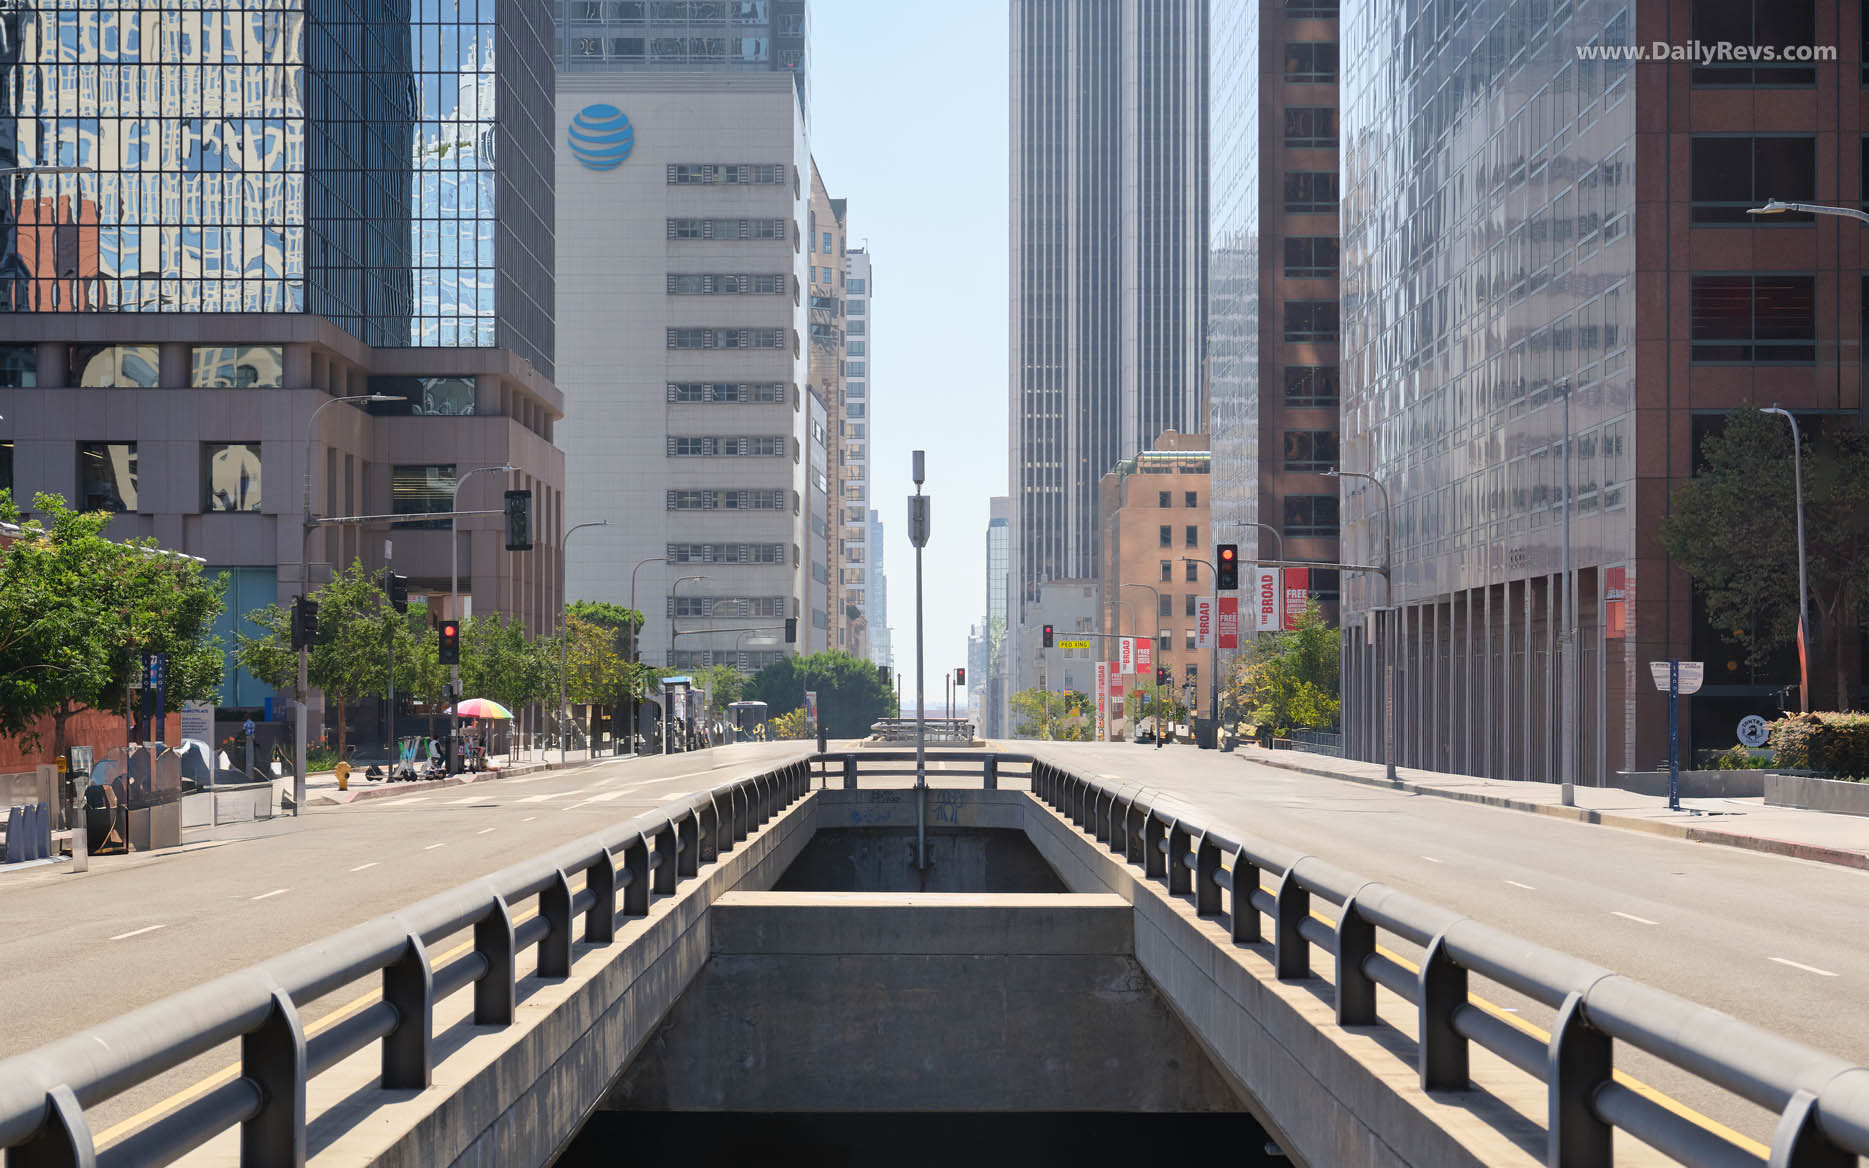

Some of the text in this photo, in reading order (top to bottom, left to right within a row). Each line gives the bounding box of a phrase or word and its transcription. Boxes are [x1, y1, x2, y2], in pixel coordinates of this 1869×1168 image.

[1261, 574, 1274, 614] BROAD
[1287, 589, 1307, 599] FREE
[1199, 602, 1210, 634] BROAD
[1122, 640, 1130, 664] BROAD
